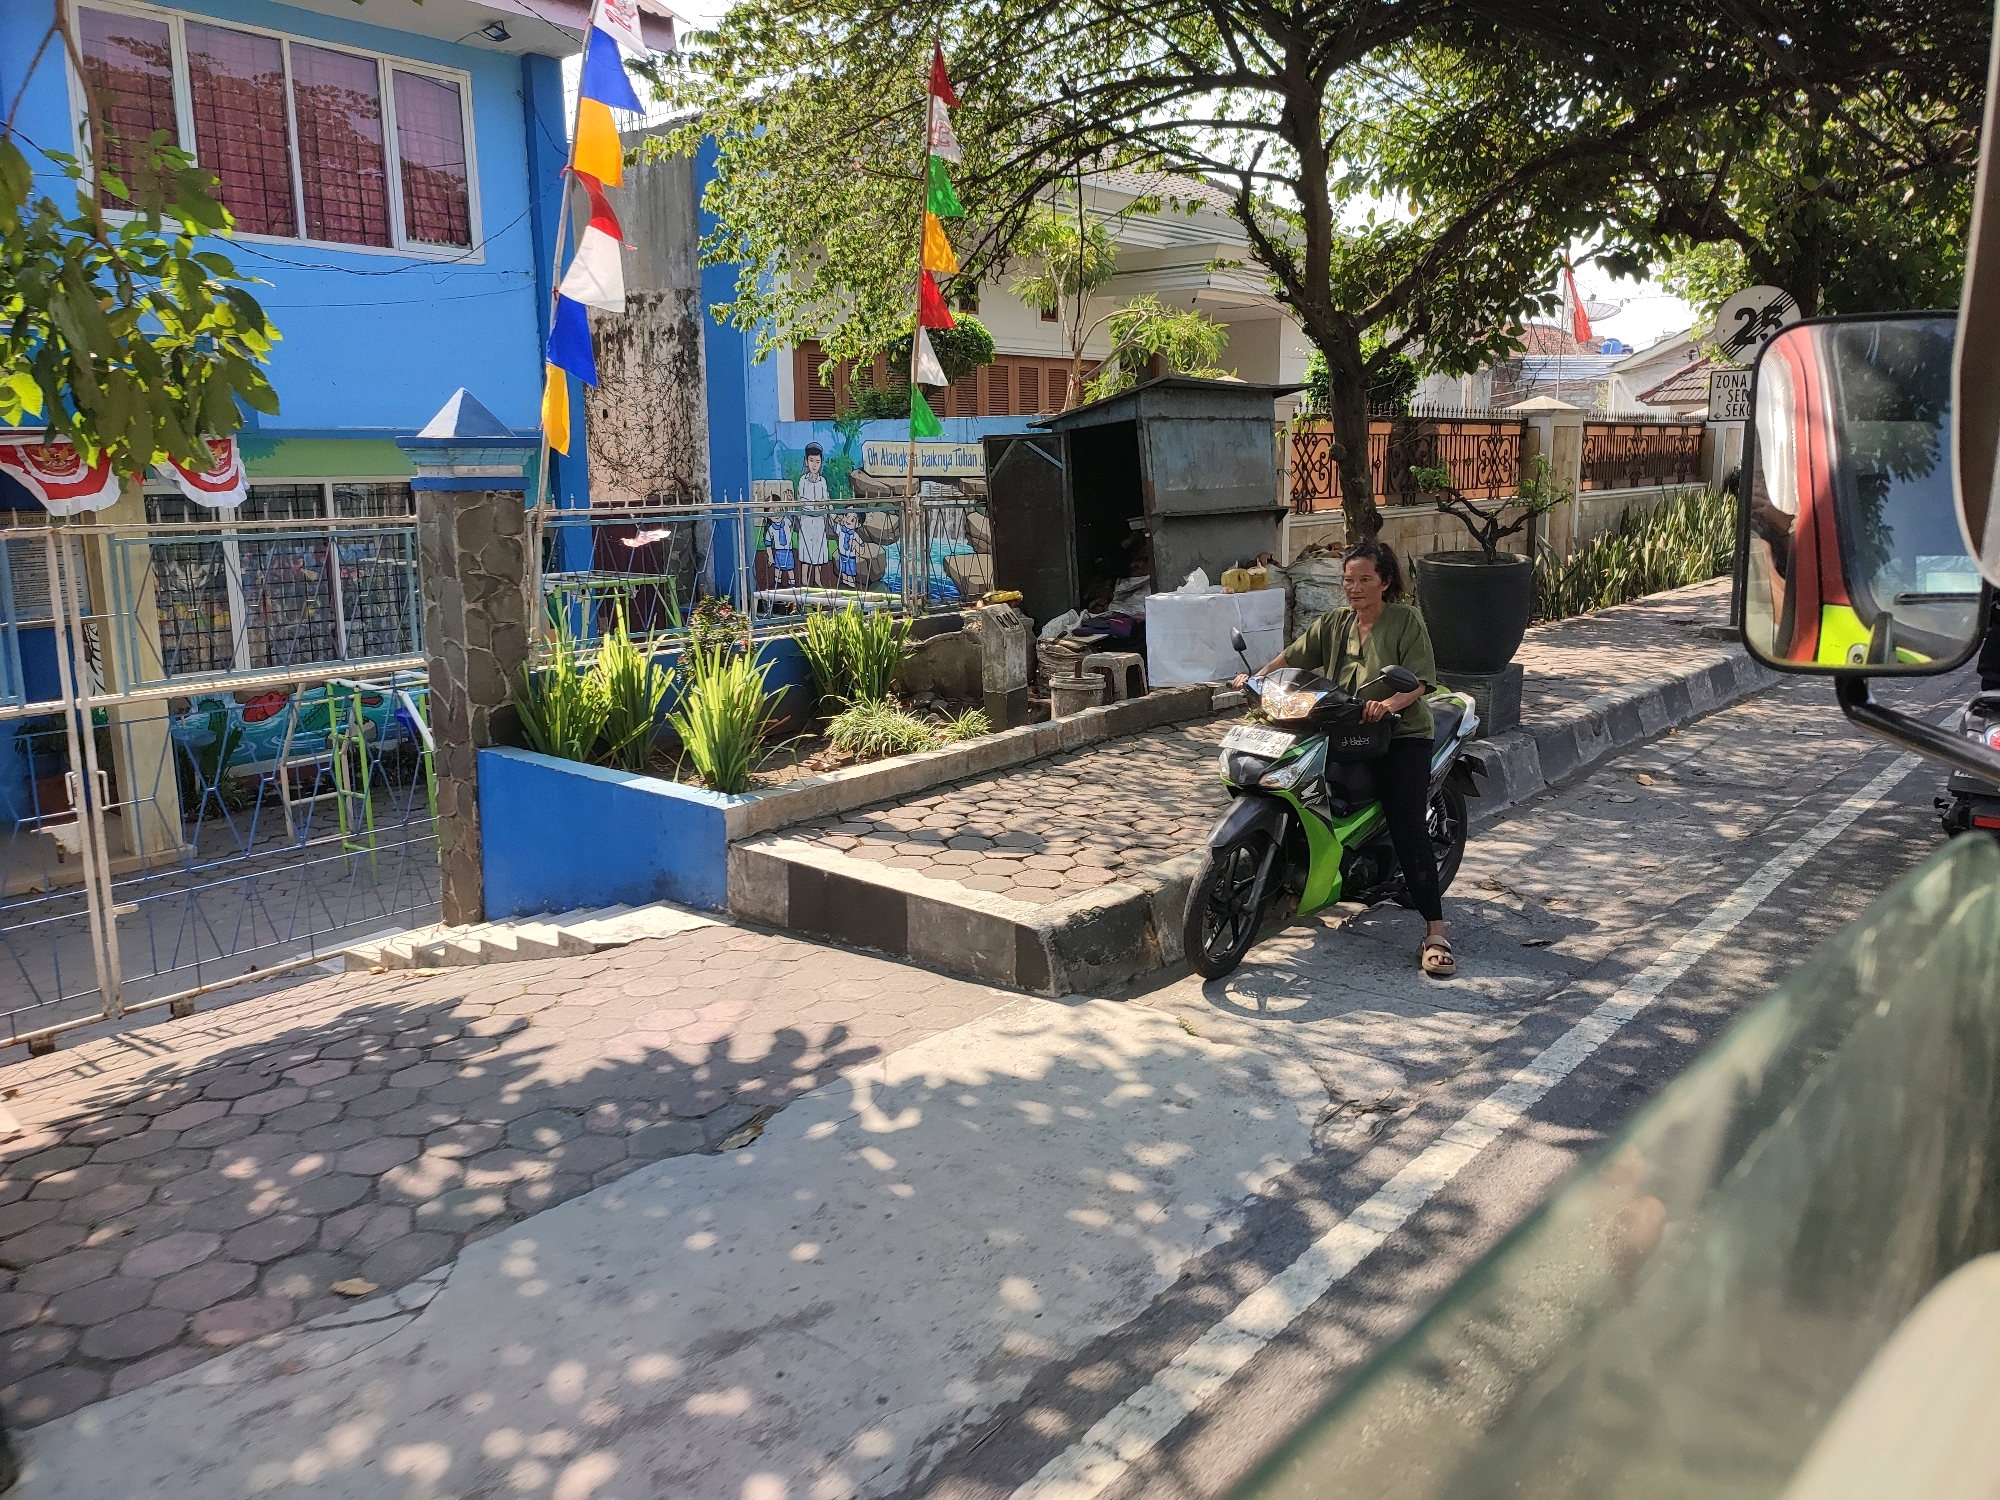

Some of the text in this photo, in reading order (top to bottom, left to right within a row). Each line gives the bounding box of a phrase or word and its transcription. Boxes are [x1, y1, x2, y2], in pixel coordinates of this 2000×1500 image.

[1734, 306, 1783, 346] 25
[1715, 374, 1747, 389] ZONA
[867, 447, 879, 466] Oh
[921, 449, 953, 472] baiknya
[952, 447, 978, 468] Tuhan
[1228, 727, 1245, 738] AA
